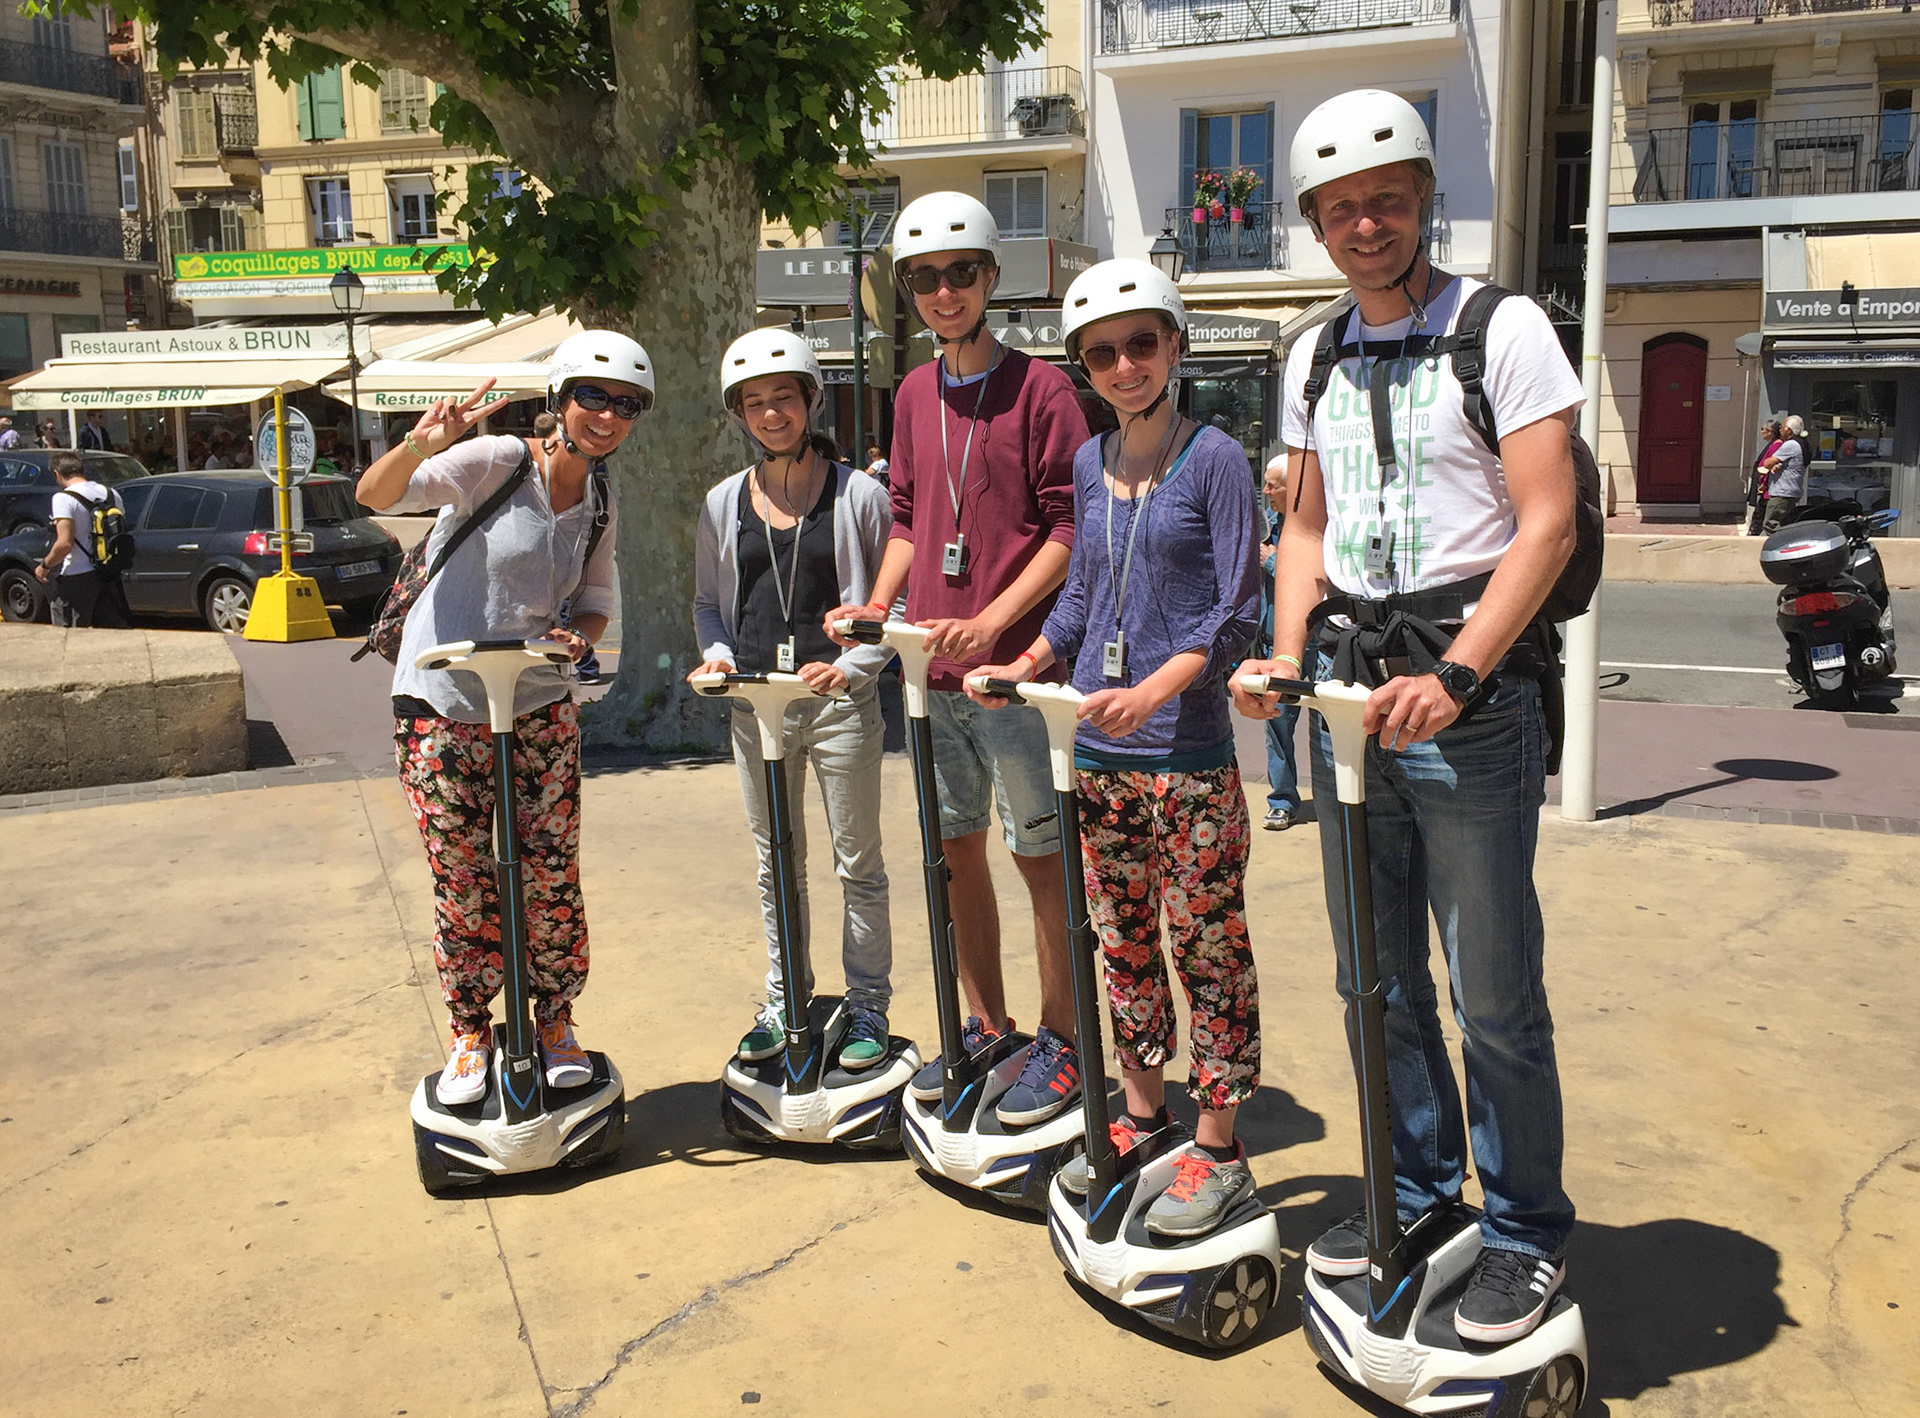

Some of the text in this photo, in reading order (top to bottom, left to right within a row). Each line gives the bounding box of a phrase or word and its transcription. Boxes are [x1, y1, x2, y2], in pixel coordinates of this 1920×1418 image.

[211, 253, 320, 275] coquillages
[325, 250, 376, 269] BRUN
[383, 253, 428, 269] depi
[785, 261, 816, 275] LE
[1776, 299, 1832, 317] Vente
[1858, 297, 1920, 320] Empor
[70, 330, 311, 354] Restaurant Astoux & BRUN
[1187, 323, 1260, 343] Emporter
[1789, 353, 1850, 364] Coquillages
[60, 390, 153, 405] Coquillages
[157, 388, 205, 402] BRUN
[375, 392, 469, 406] Restauran
[1327, 356, 1441, 422] GOOD
[1329, 413, 1430, 444] THINGS ME TO
[1326, 436, 1435, 495] THOSE
